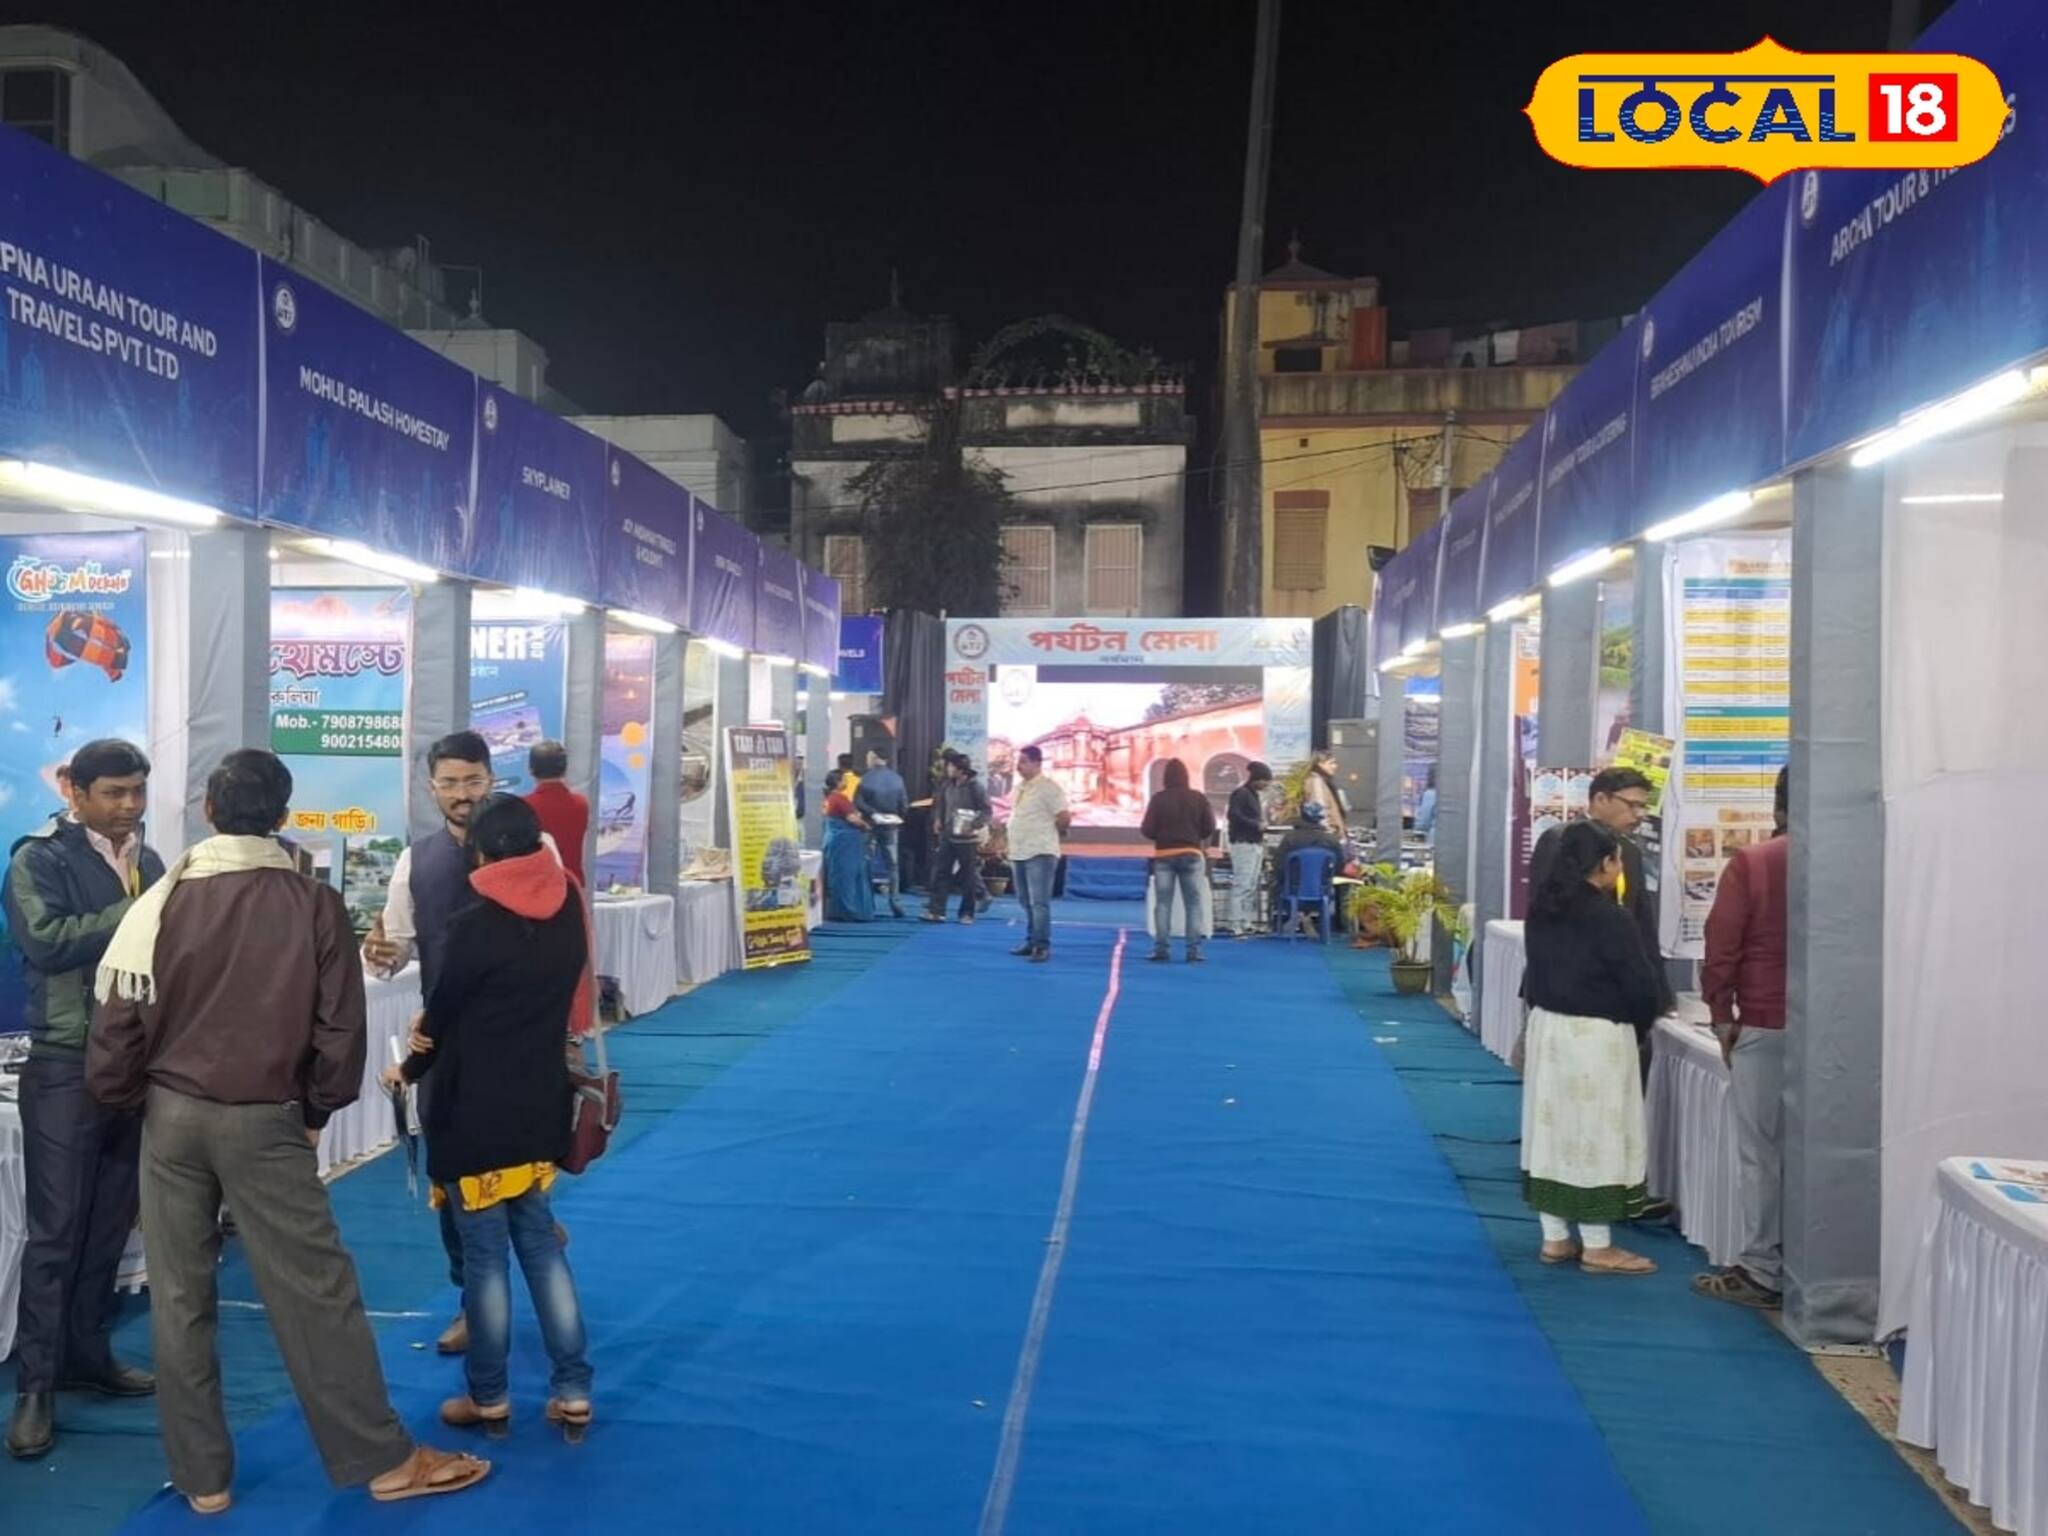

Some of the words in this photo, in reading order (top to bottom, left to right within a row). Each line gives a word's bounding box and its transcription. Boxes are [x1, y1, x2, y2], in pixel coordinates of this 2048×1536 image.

[1873, 170, 1916, 230] TOUR
[0, 241, 49, 289] PNA
[52, 263, 124, 321] URAAN
[127, 297, 178, 342] TOUR
[180, 322, 217, 357] AND
[6, 287, 103, 351] TRAVELS
[105, 328, 143, 367] PVT
[147, 344, 179, 380] LTD
[300, 365, 346, 408] MOHUL
[349, 387, 393, 427] PALASH
[396, 409, 450, 451] HOMESTAY
[321, 714, 403, 729] 790879868
[321, 734, 403, 749] 900215480
